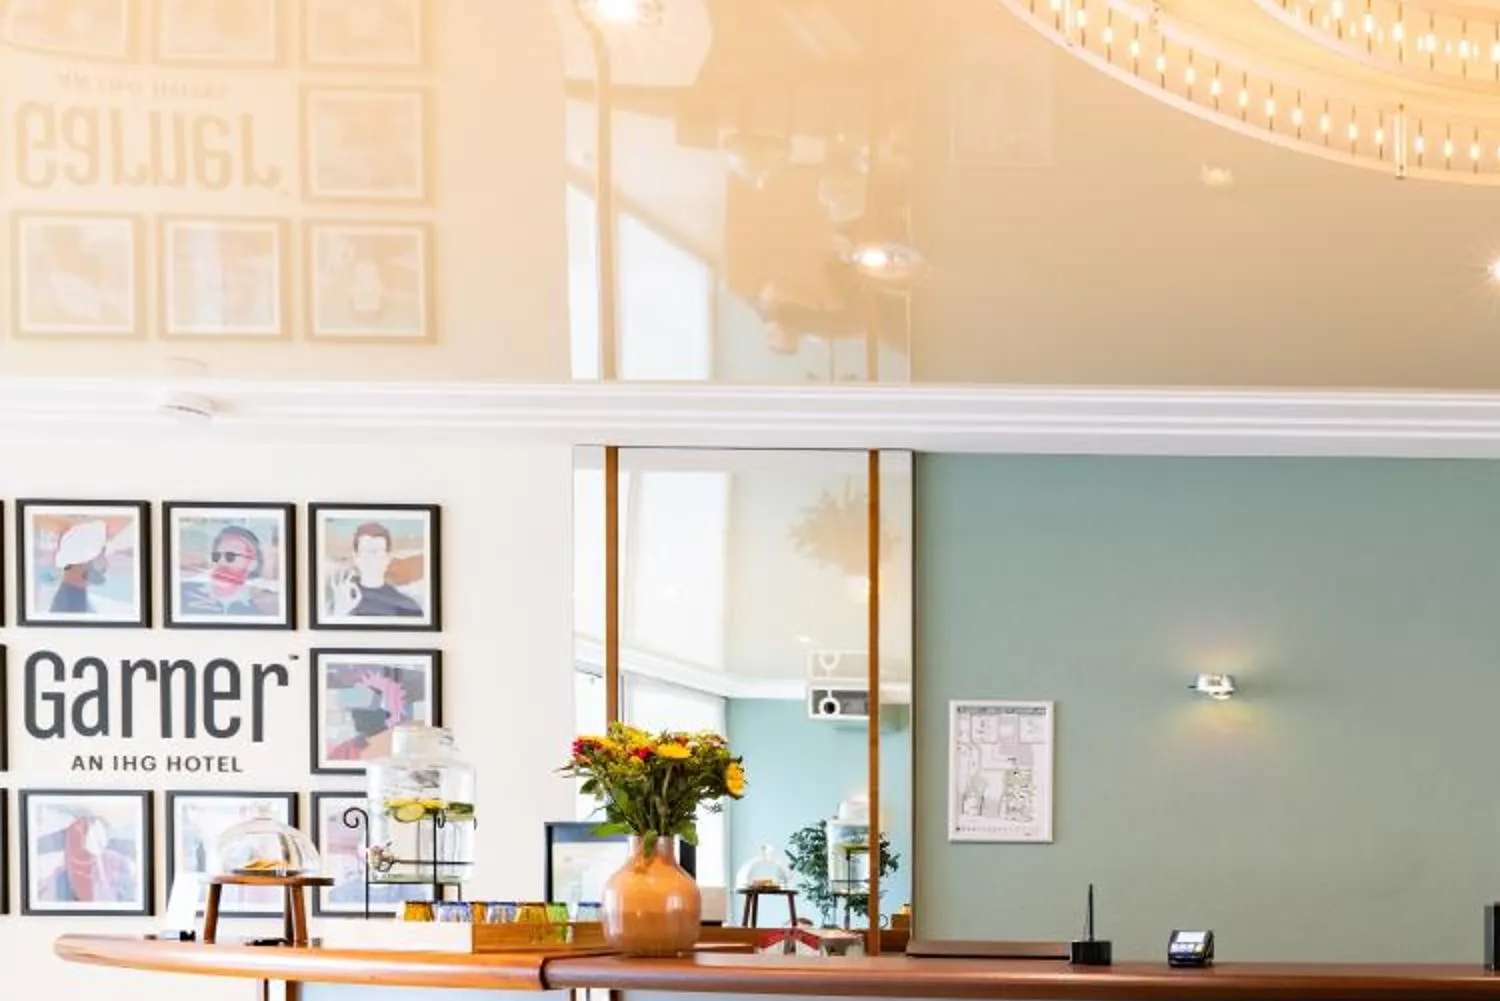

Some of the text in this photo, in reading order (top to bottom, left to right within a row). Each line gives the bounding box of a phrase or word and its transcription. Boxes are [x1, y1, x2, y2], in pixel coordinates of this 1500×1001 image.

[24, 649, 289, 742] Garner
[71, 755, 243, 773] AN IHG HOTEL
